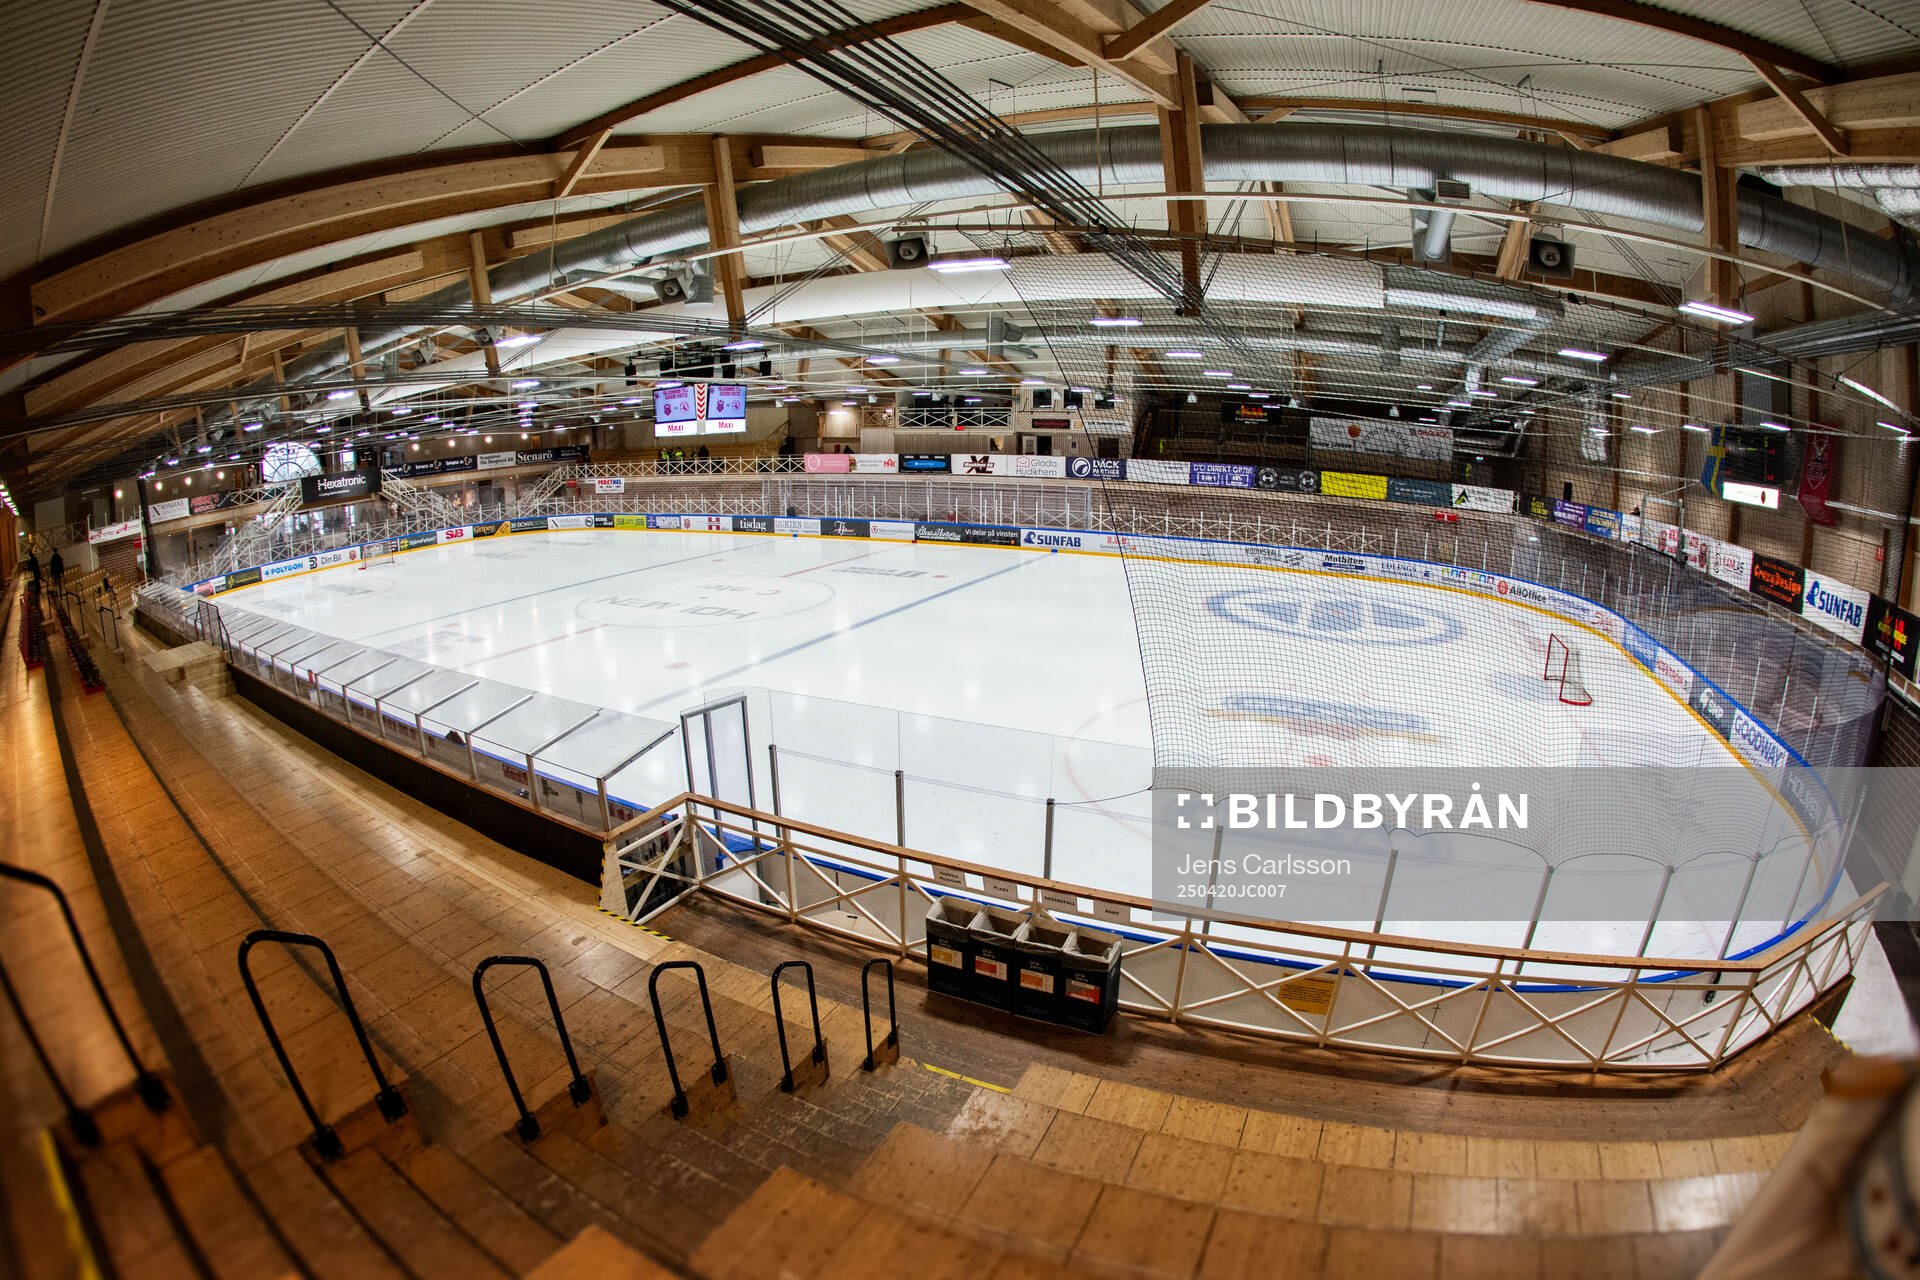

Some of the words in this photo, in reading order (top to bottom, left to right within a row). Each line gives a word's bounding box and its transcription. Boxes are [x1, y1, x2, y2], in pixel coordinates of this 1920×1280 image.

[517, 450, 553, 462] Stenarö
[1030, 456, 1057, 467] Glada
[1016, 468, 1057, 476] Hudikhem
[317, 474, 367, 491] Hexatronic
[473, 524, 496, 534] Gripen
[740, 518, 767, 533] tisdag
[987, 529, 995, 538] på
[1037, 534, 1082, 548] SUNFAB
[321, 555, 333, 565] Din
[333, 552, 342, 562] Bil
[1324, 554, 1364, 565] Matbiten
[270, 562, 304, 575] POLYGON
[1509, 584, 1547, 604] AllOffice
[1818, 590, 1863, 628] SUNFAB
[1735, 714, 1785, 768] GOODWAY
